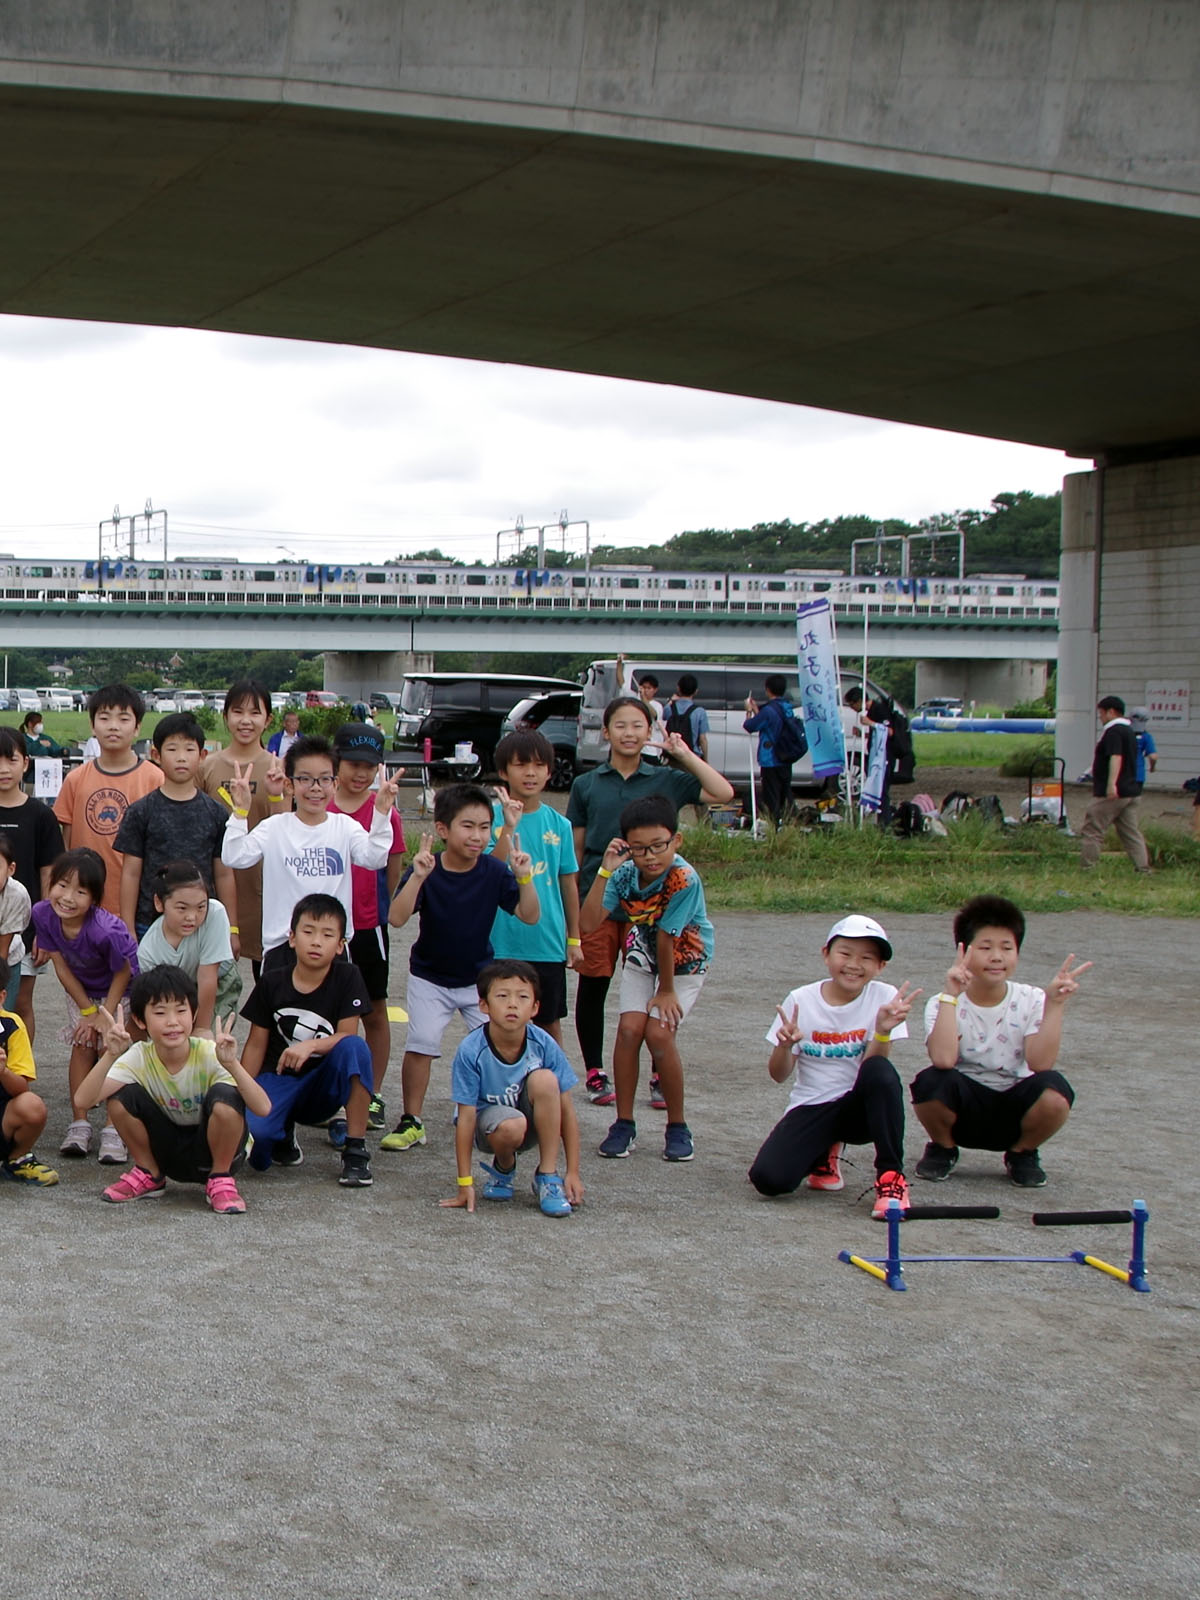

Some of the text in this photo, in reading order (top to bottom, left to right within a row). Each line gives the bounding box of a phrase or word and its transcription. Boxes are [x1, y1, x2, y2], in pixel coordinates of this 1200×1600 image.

[302, 847, 325, 857] THE
[285, 856, 325, 867] NORTH
[297, 866, 325, 877] FACE
